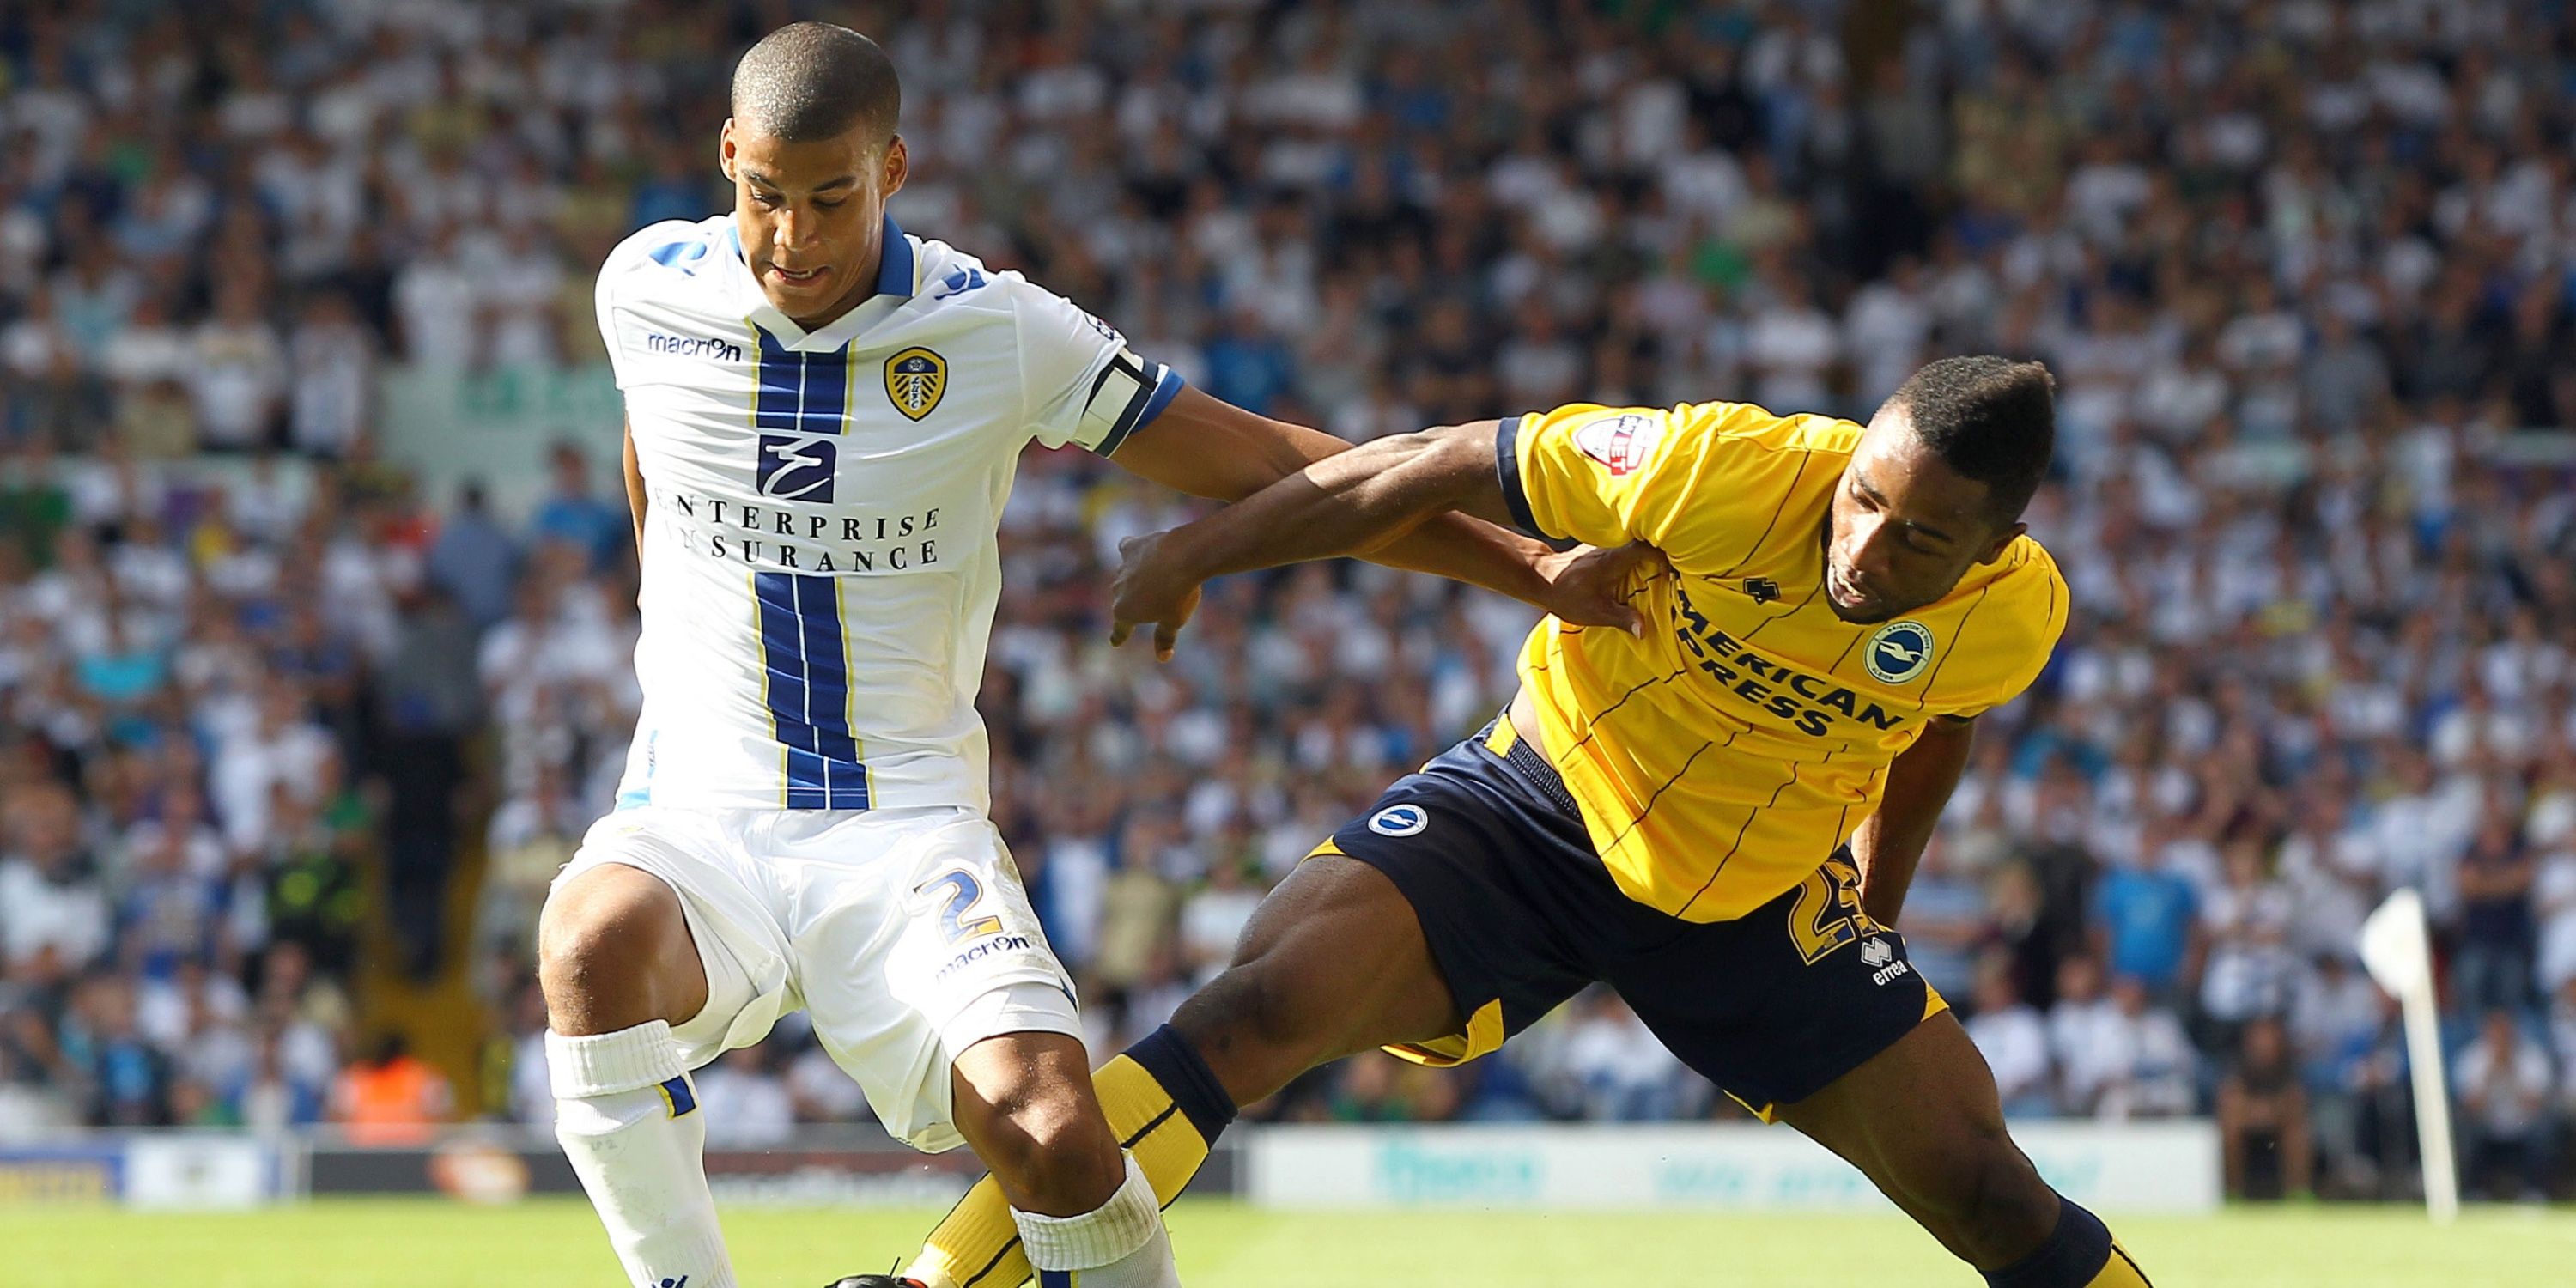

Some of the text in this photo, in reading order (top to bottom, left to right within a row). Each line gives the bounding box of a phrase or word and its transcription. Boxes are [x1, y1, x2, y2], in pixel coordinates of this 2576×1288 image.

[1676, 587, 1904, 731] MERICAN
[1676, 627, 1834, 737] PRESS
[913, 867, 1004, 945] 2
